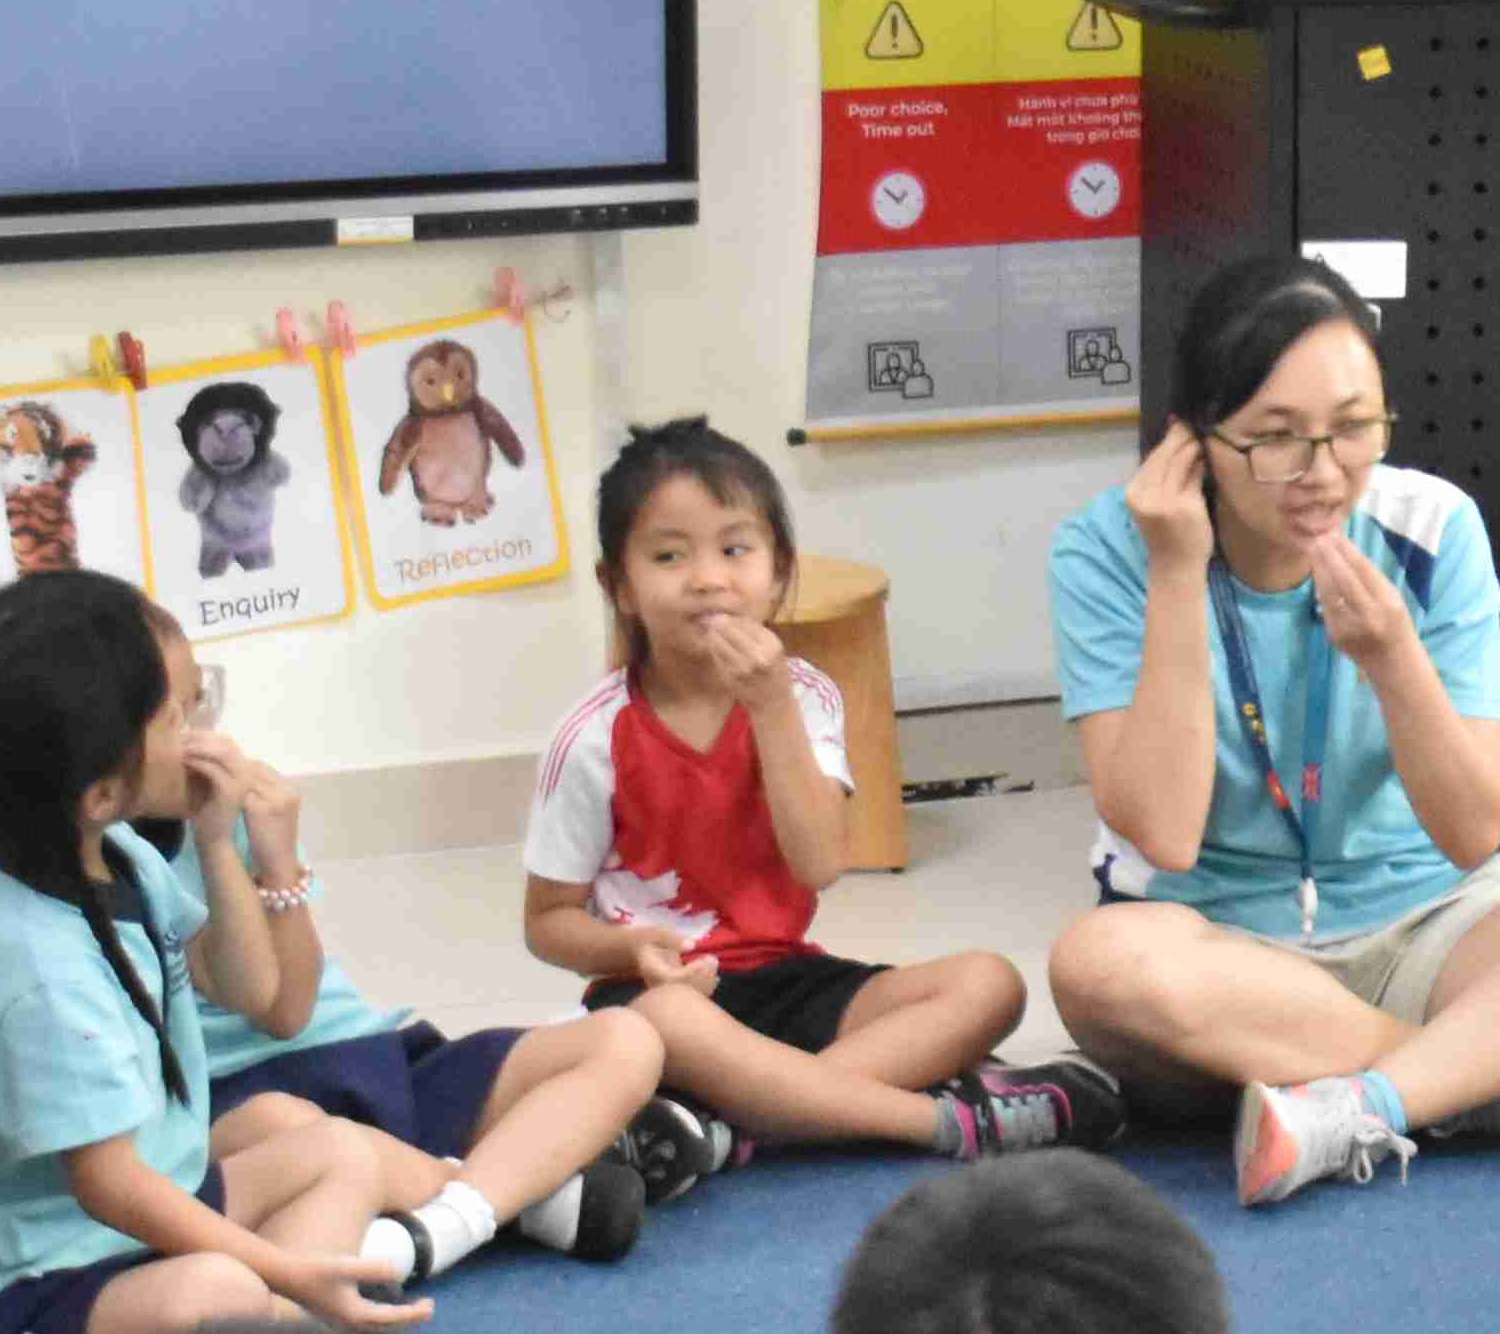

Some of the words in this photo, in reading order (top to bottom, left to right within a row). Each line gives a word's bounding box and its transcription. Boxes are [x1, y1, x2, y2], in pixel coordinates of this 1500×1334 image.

[848, 102, 885, 118] Poor
[891, 101, 949, 117] choice,
[861, 123, 902, 138] Time
[907, 123, 934, 136] out
[394, 537, 534, 583] Reflection
[200, 586, 302, 626] Enquiry
